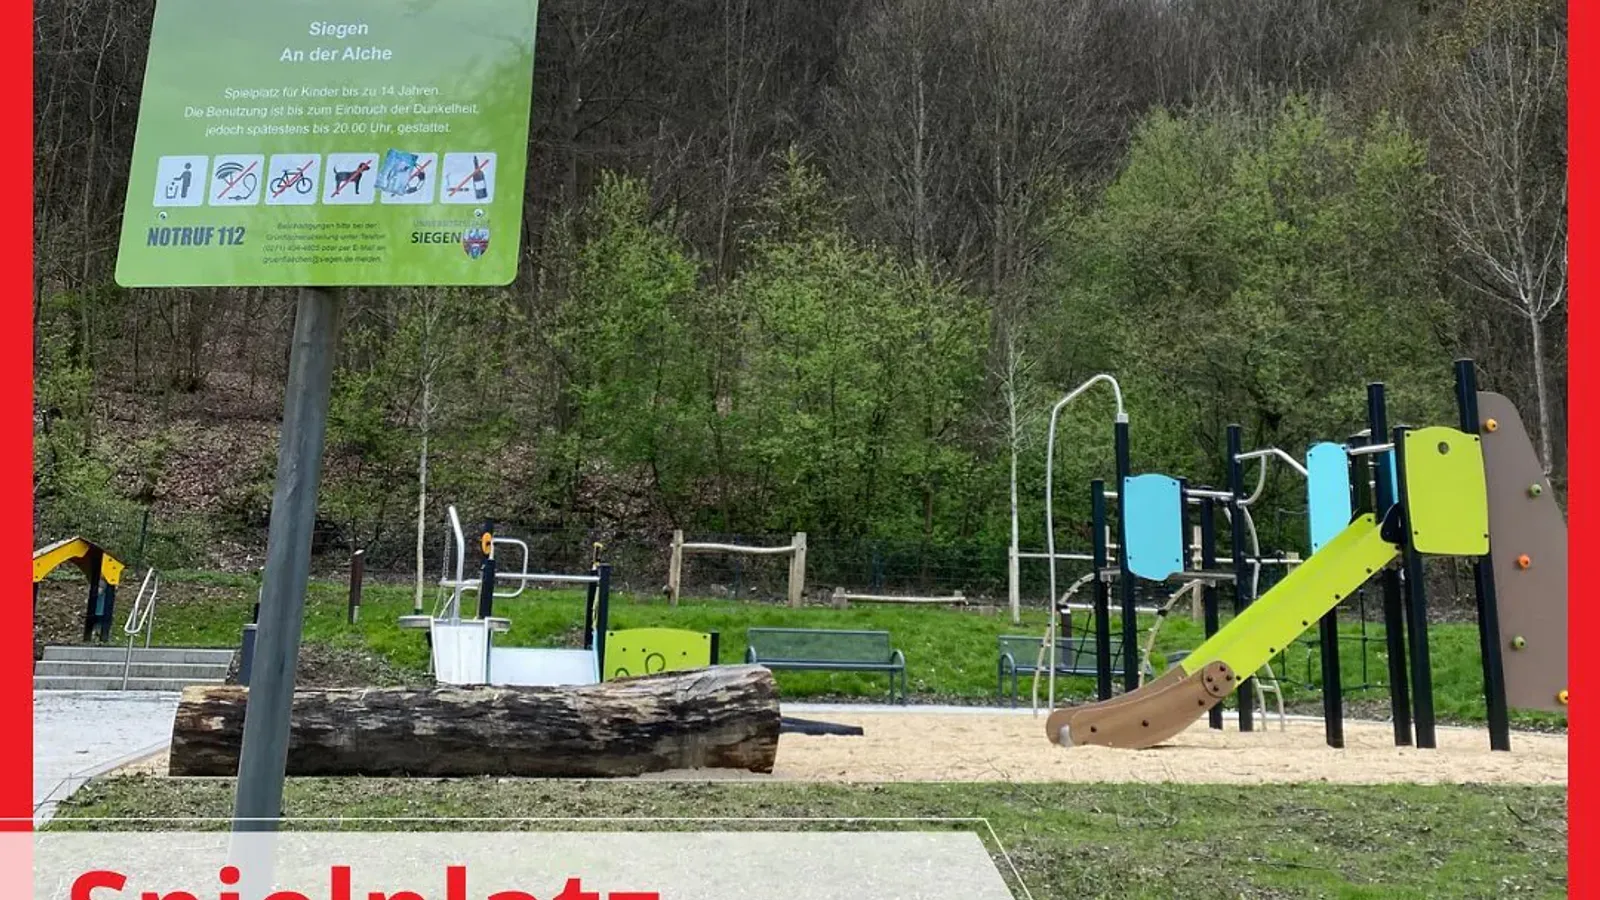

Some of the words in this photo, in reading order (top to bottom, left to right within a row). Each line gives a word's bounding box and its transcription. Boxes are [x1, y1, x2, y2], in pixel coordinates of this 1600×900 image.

[309, 20, 369, 39] Siegen
[280, 47, 304, 62] An
[309, 46, 338, 61] der
[342, 46, 393, 61] Alche
[224, 87, 280, 101] Spielplatz
[283, 86, 298, 98] für
[301, 86, 339, 98] Kinder
[342, 86, 360, 97] bis
[362, 87, 377, 97] zu
[381, 86, 395, 97] 14
[184, 106, 204, 118] Die
[206, 105, 268, 119] Benutzung
[270, 105, 285, 117] ist
[287, 104, 304, 116] bis
[306, 105, 333, 116] zum
[335, 104, 388, 116] Einbruch
[391, 104, 411, 115] der
[205, 124, 244, 138] jedoch
[247, 123, 310, 137] spätestens
[312, 123, 330, 135] bis
[332, 123, 367, 135] 20.00
[147, 226, 215, 247] NOTRUF
[217, 226, 246, 246] 112
[411, 231, 461, 243] SIEGEN
